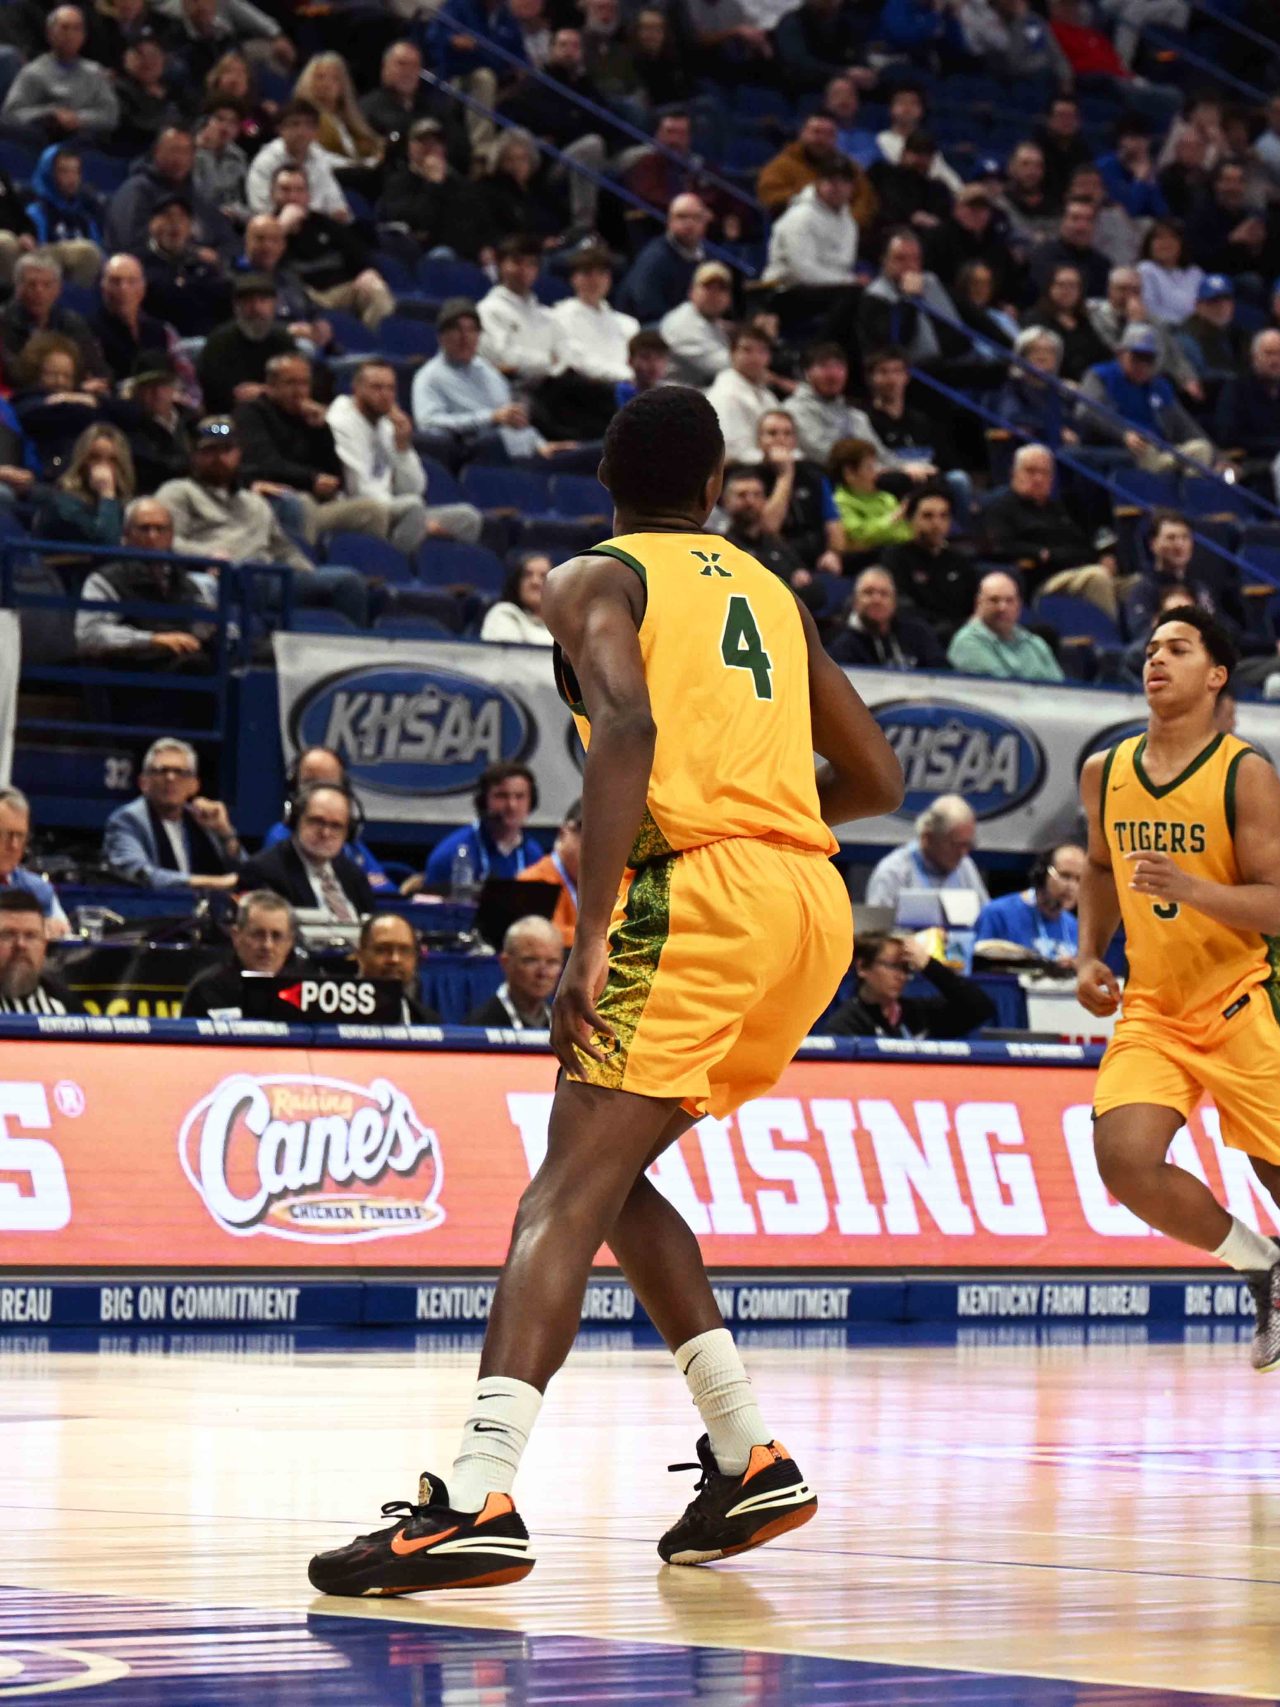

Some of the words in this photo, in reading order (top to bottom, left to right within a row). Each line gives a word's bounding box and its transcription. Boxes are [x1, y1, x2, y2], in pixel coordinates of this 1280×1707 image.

[721, 594, 773, 701] 4
[325, 686, 500, 764] KHSAA
[885, 722, 1018, 794] HSAA
[1114, 821, 1206, 853] TIGERS
[301, 980, 376, 1015] POSS
[200, 1076, 431, 1223] Cane's
[100, 1287, 133, 1321] BIG
[138, 1286, 166, 1320] ON
[171, 1286, 300, 1320] COMMITMENT
[581, 1288, 635, 1321] UREAU
[738, 1287, 851, 1320] COMMITMENT
[957, 1285, 1041, 1316] KENTUCKY
[1042, 1285, 1086, 1316] FARM
[1088, 1286, 1150, 1316] BUREAU
[1185, 1286, 1212, 1316] BIG
[1214, 1286, 1237, 1316] ON
